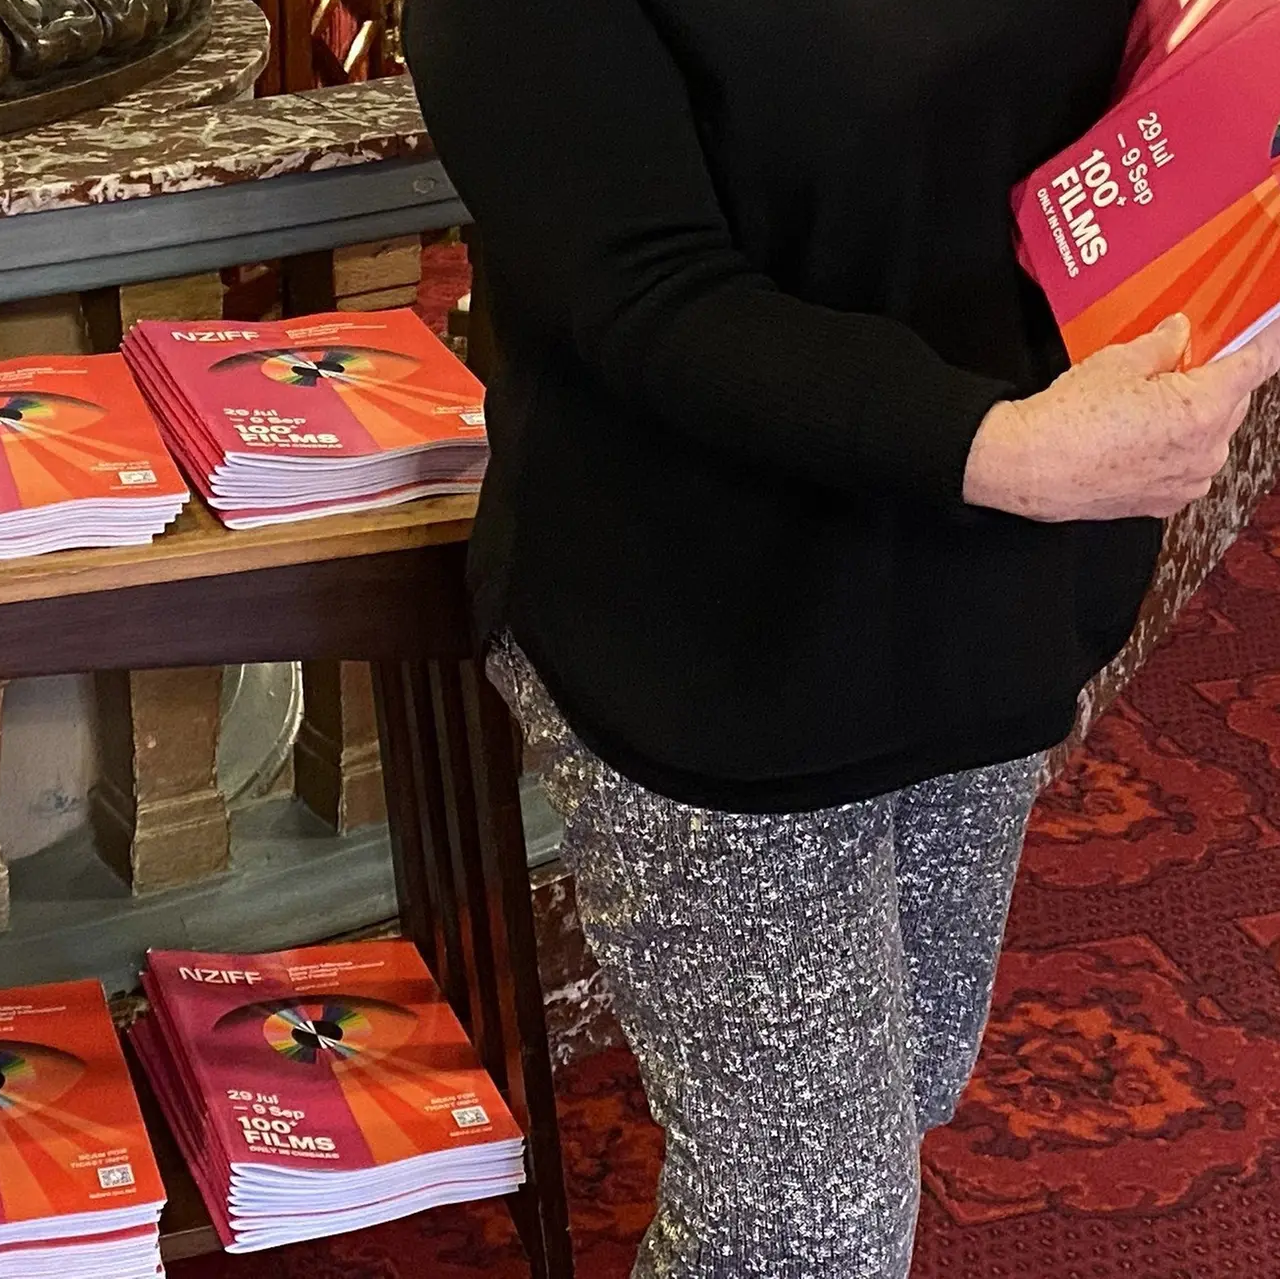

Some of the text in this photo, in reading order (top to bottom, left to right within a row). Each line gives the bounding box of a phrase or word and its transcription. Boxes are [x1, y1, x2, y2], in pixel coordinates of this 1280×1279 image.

[1136, 112, 1175, 168] 29 Jul
[1121, 147, 1141, 167] 9
[1128, 163, 1154, 205] Sep
[1052, 166, 1108, 266] FILMS
[1036, 187, 1080, 278] ONLY IN CINEMAS
[171, 330, 260, 341] NZIFF
[239, 433, 340, 444] FILMS
[178, 967, 262, 985] NZIFF
[255, 1093, 279, 1105] Jul
[268, 1105, 305, 1121] Sep
[243, 1129, 336, 1151] FILMS
